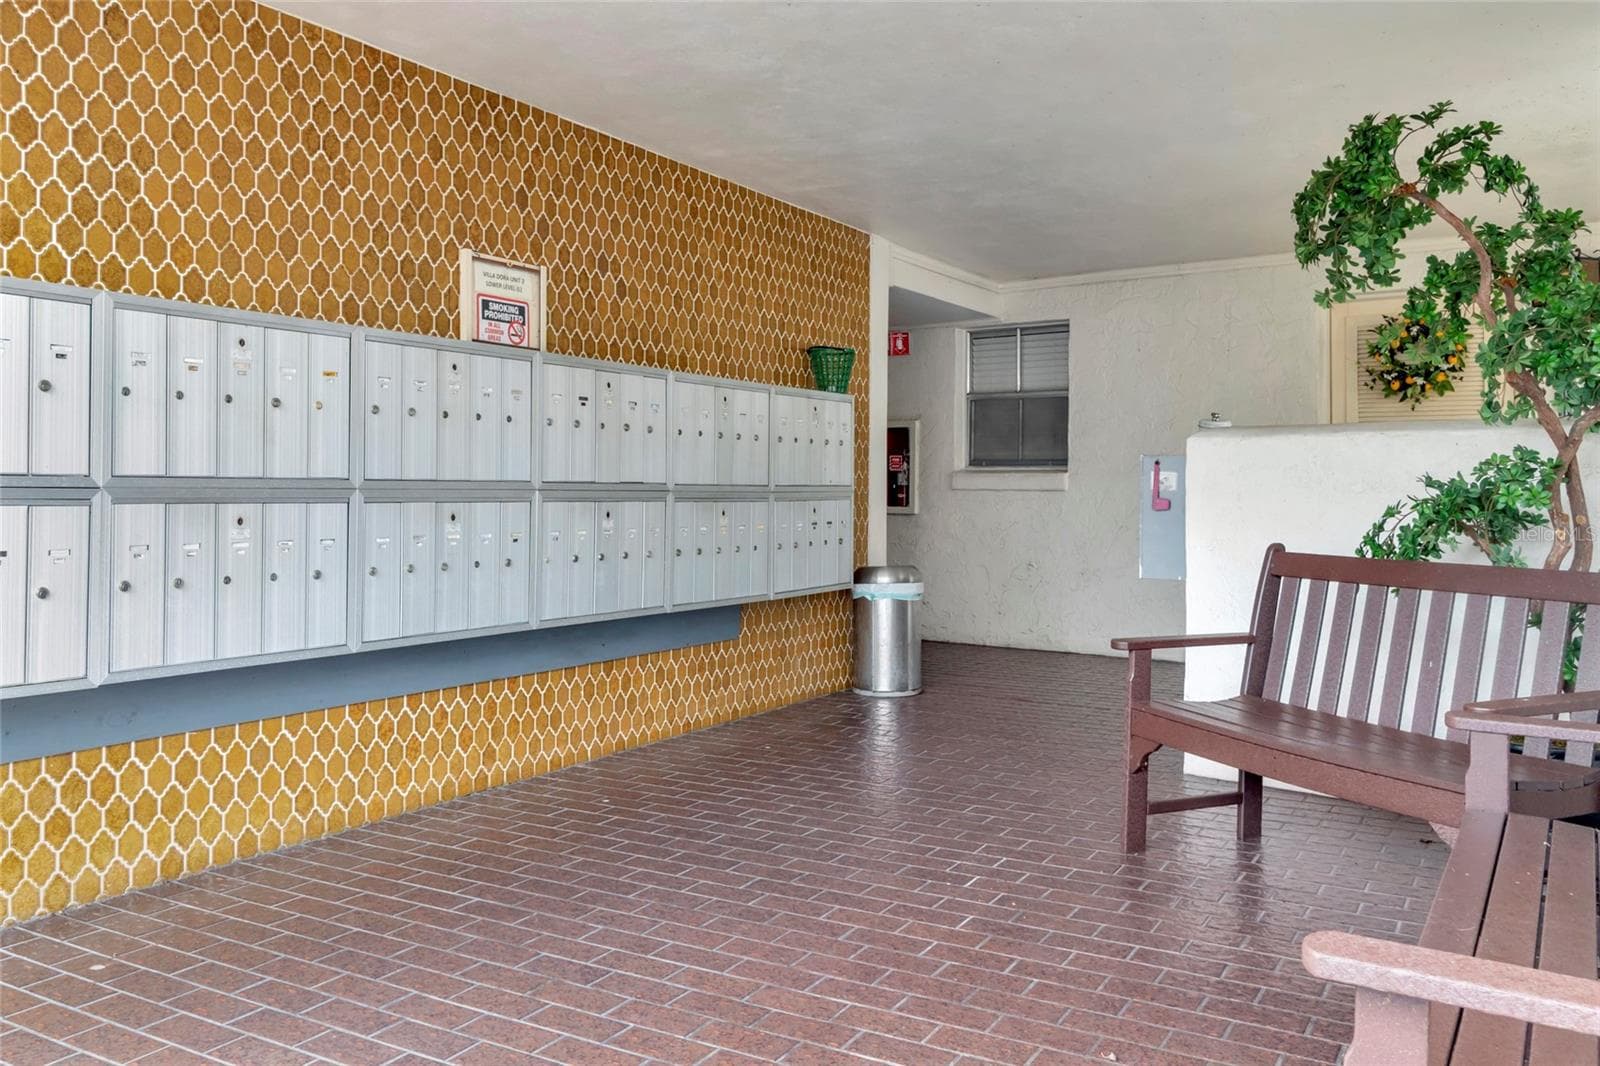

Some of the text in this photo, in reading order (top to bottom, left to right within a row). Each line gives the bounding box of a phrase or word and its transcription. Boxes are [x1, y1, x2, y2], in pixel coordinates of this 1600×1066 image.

[485, 280, 502, 289] LOWER
[503, 283, 515, 291] LEVEL
[488, 302, 519, 315] SMOKING
[484, 310, 523, 323] PROHIBITED
